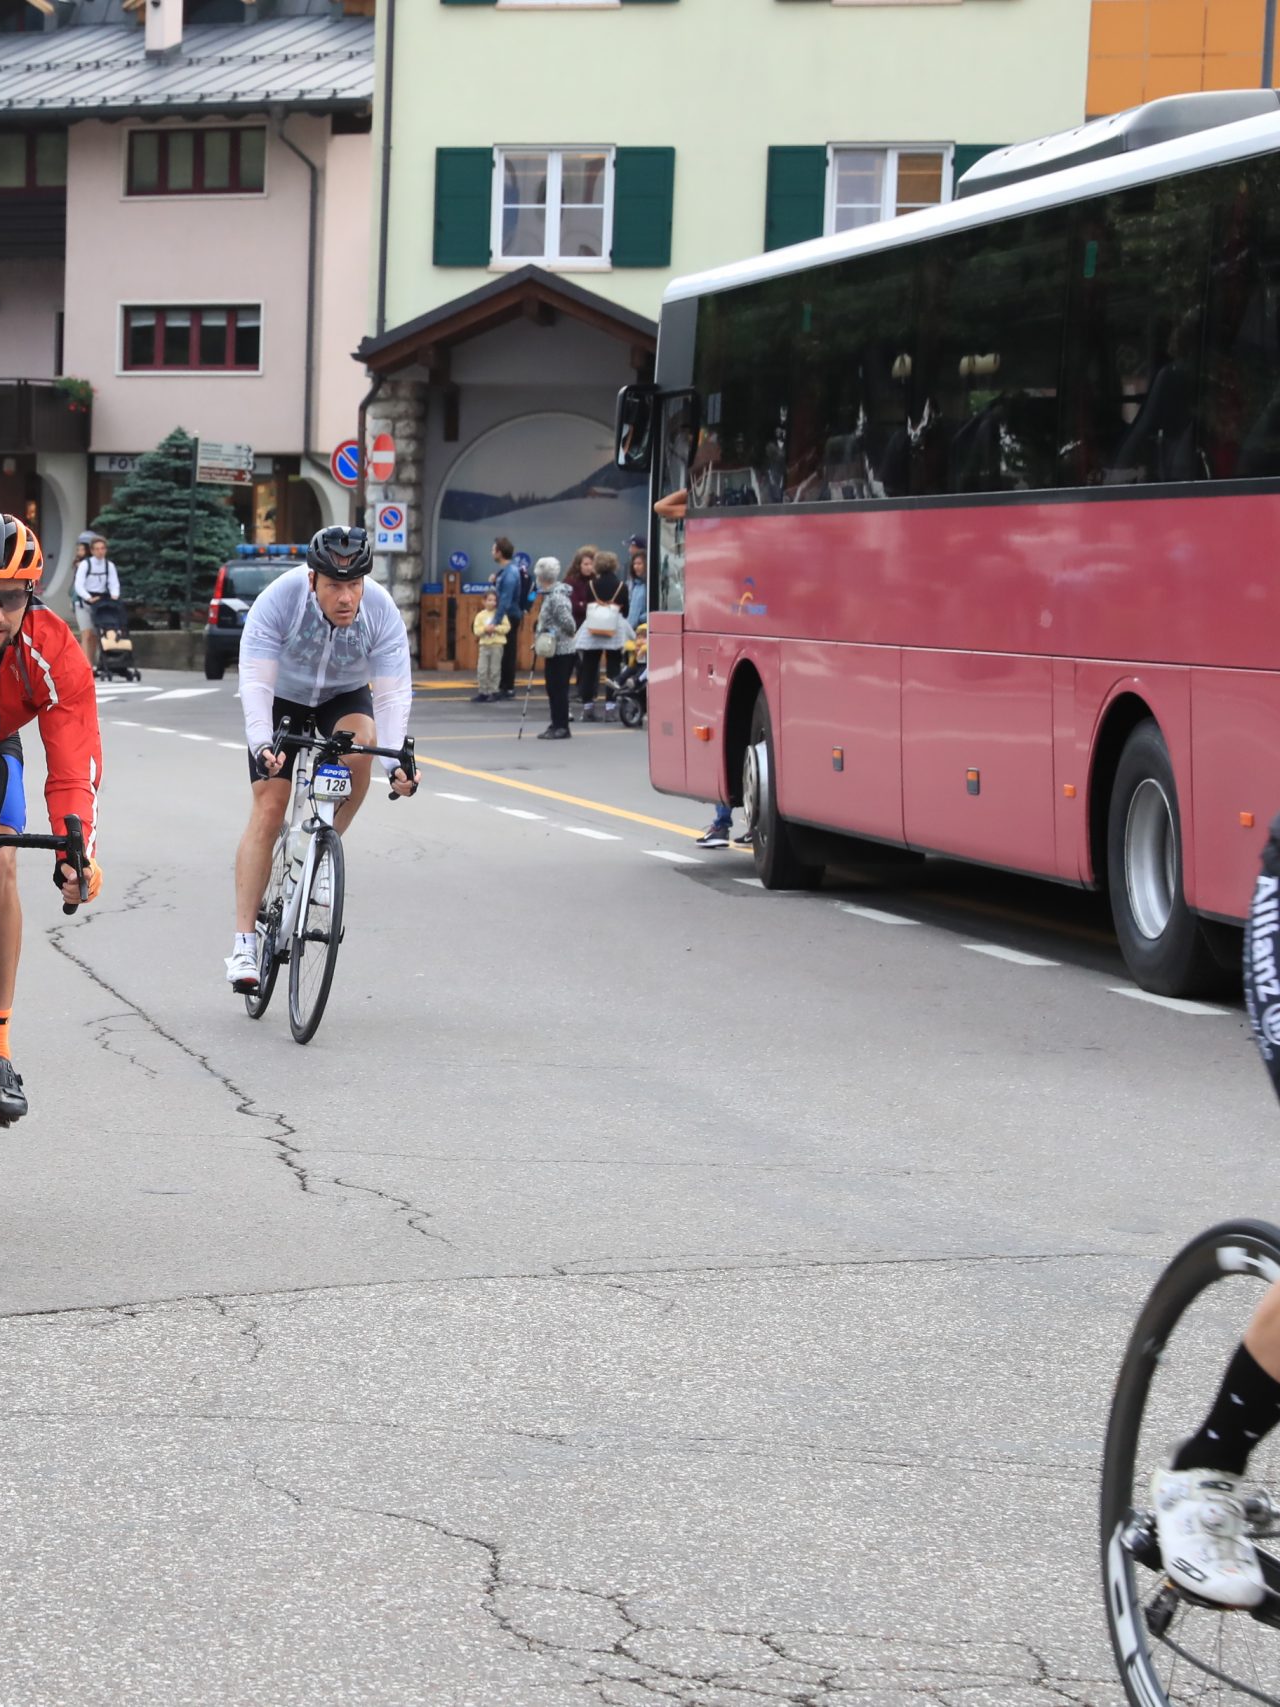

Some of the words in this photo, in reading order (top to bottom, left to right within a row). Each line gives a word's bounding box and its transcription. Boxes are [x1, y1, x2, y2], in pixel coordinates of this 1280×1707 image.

[109, 457, 143, 470] FOT
[325, 778, 347, 792] 128
[1252, 874, 1280, 1002] Allianz
